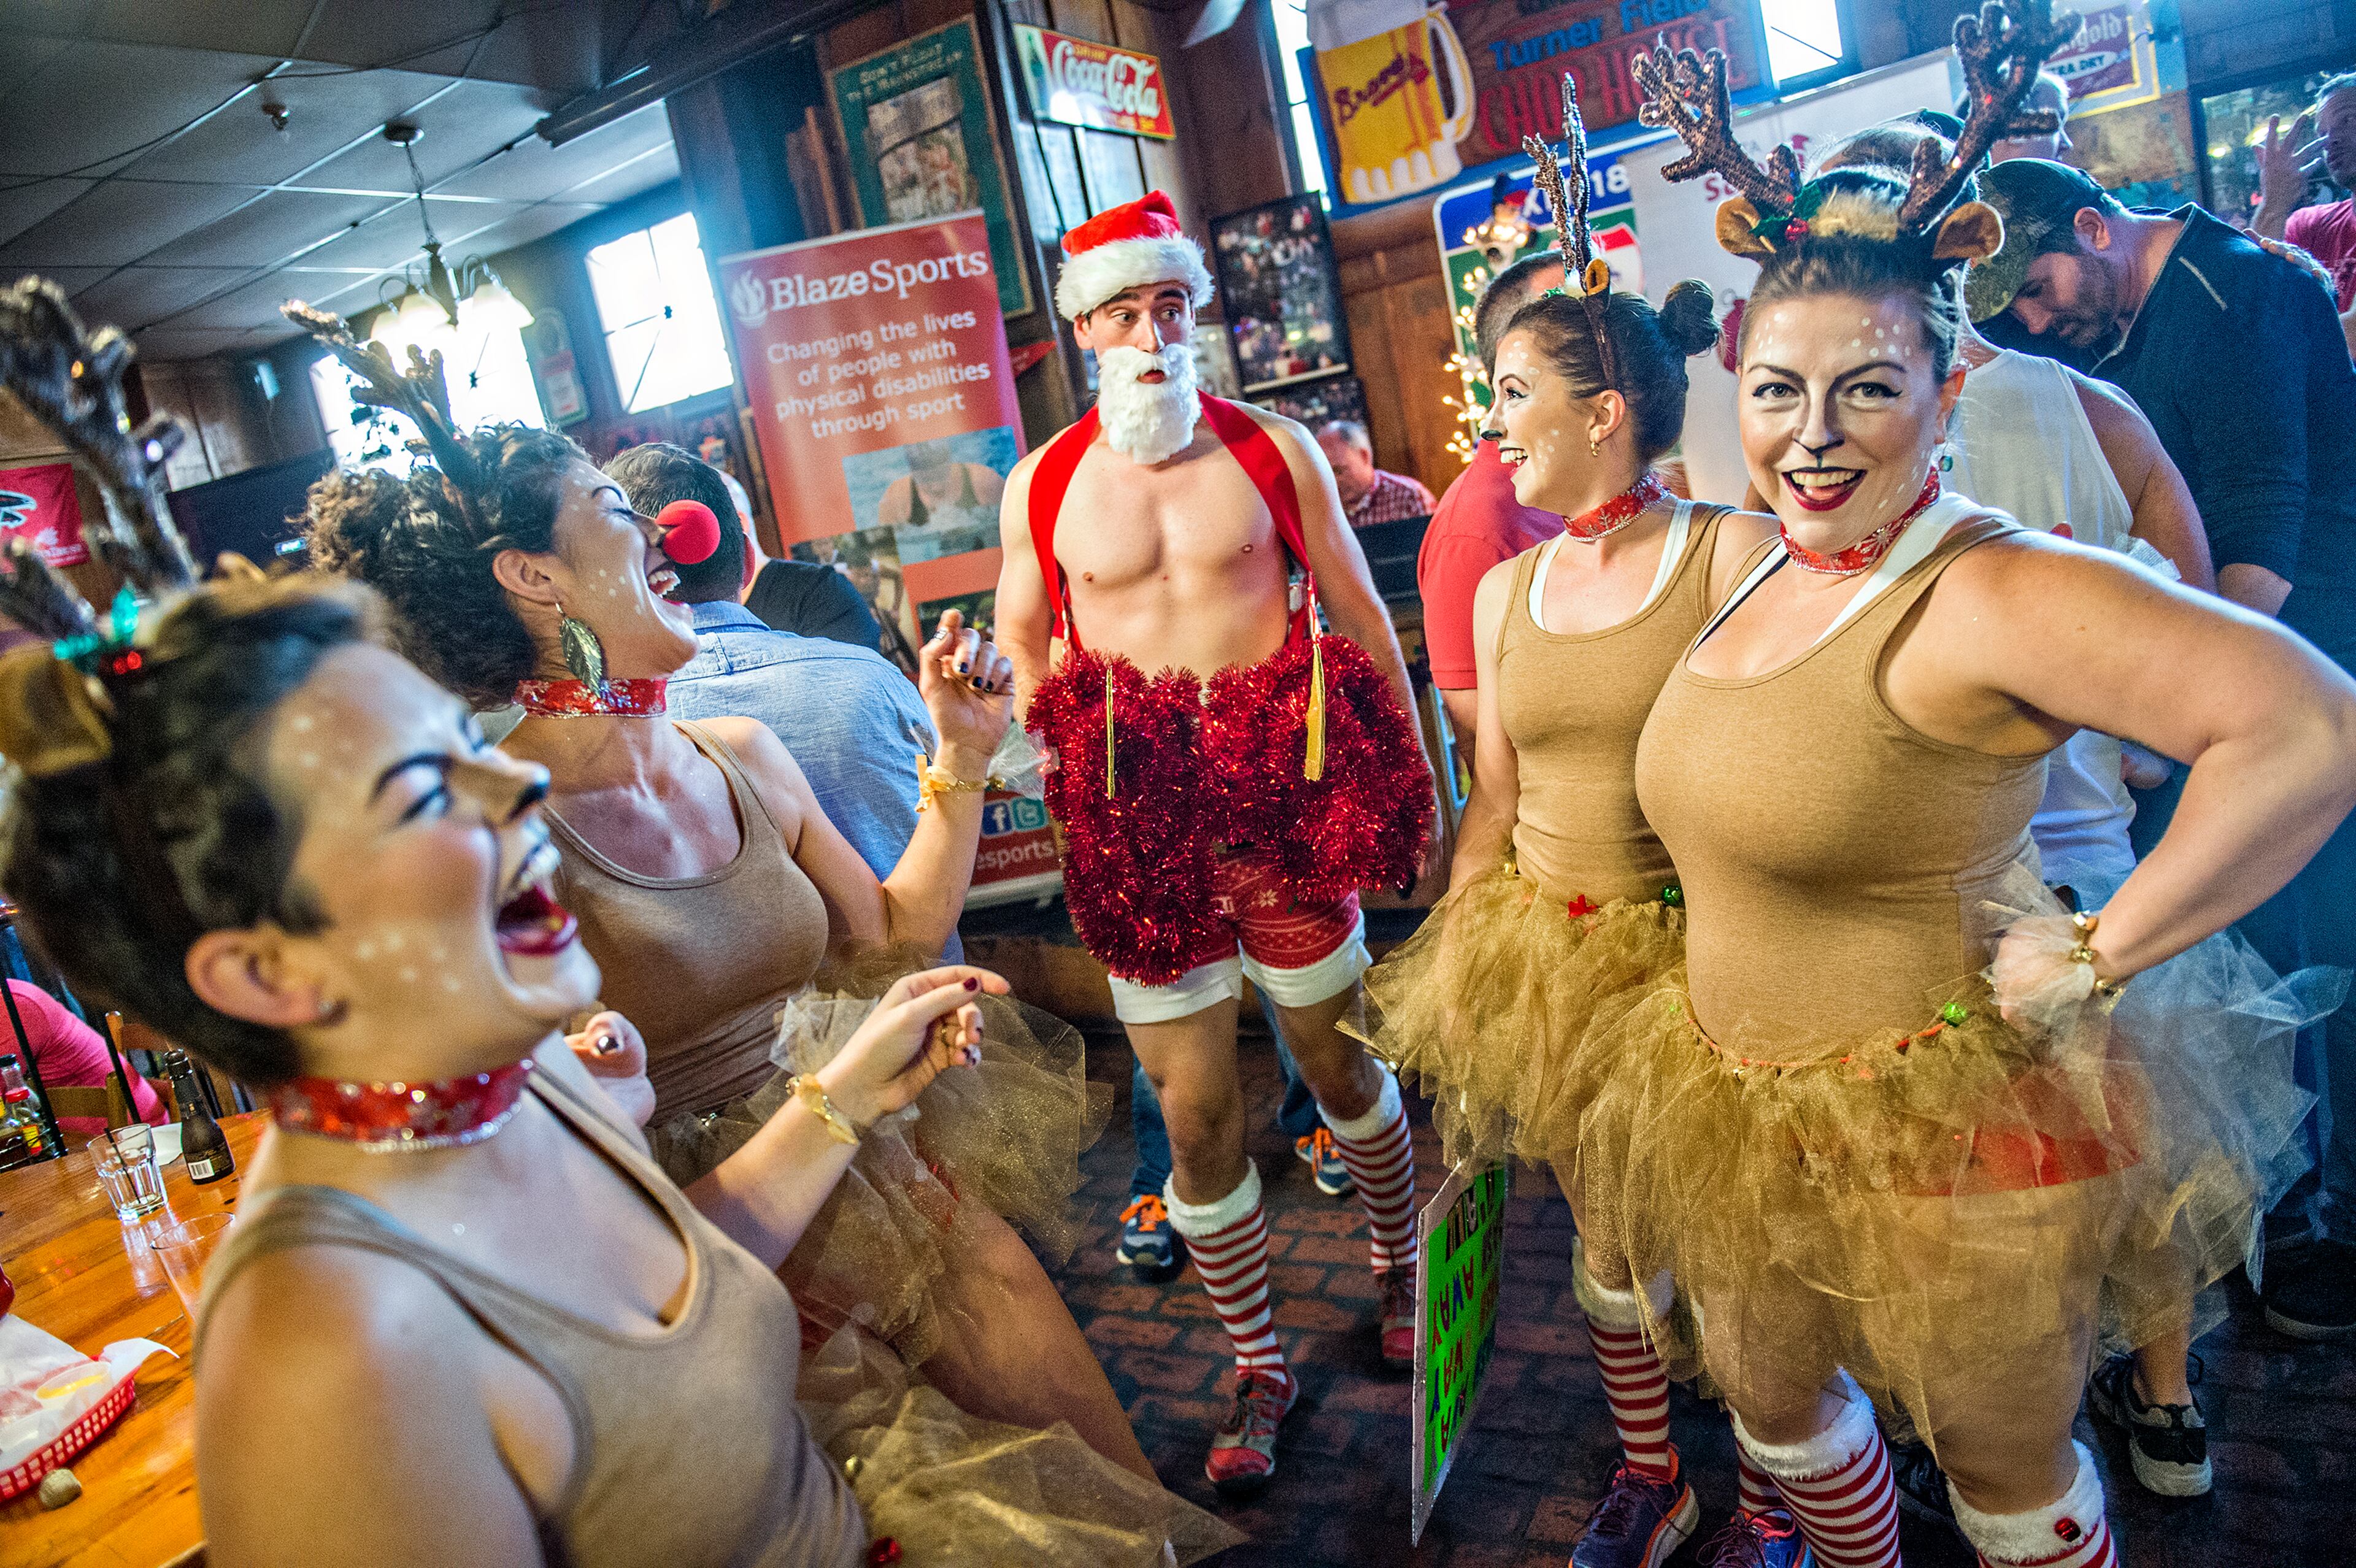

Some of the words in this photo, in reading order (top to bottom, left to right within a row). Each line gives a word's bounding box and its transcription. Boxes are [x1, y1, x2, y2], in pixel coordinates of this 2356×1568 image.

[1489, 17, 1603, 72] Turner
[1479, 65, 1585, 151] CHOP
[1590, 164, 1631, 199] 18
[769, 250, 989, 312] BlazeSports
[767, 330, 874, 364] Changing
[879, 320, 918, 343] the
[923, 311, 977, 334] lives
[798, 363, 821, 386] of
[828, 350, 901, 384] people
[907, 338, 957, 364] with
[776, 383, 867, 422] physical
[872, 363, 991, 399] disabilities
[810, 404, 899, 439] through
[907, 392, 966, 421] sport
[1431, 1256, 1474, 1355] AWAY
